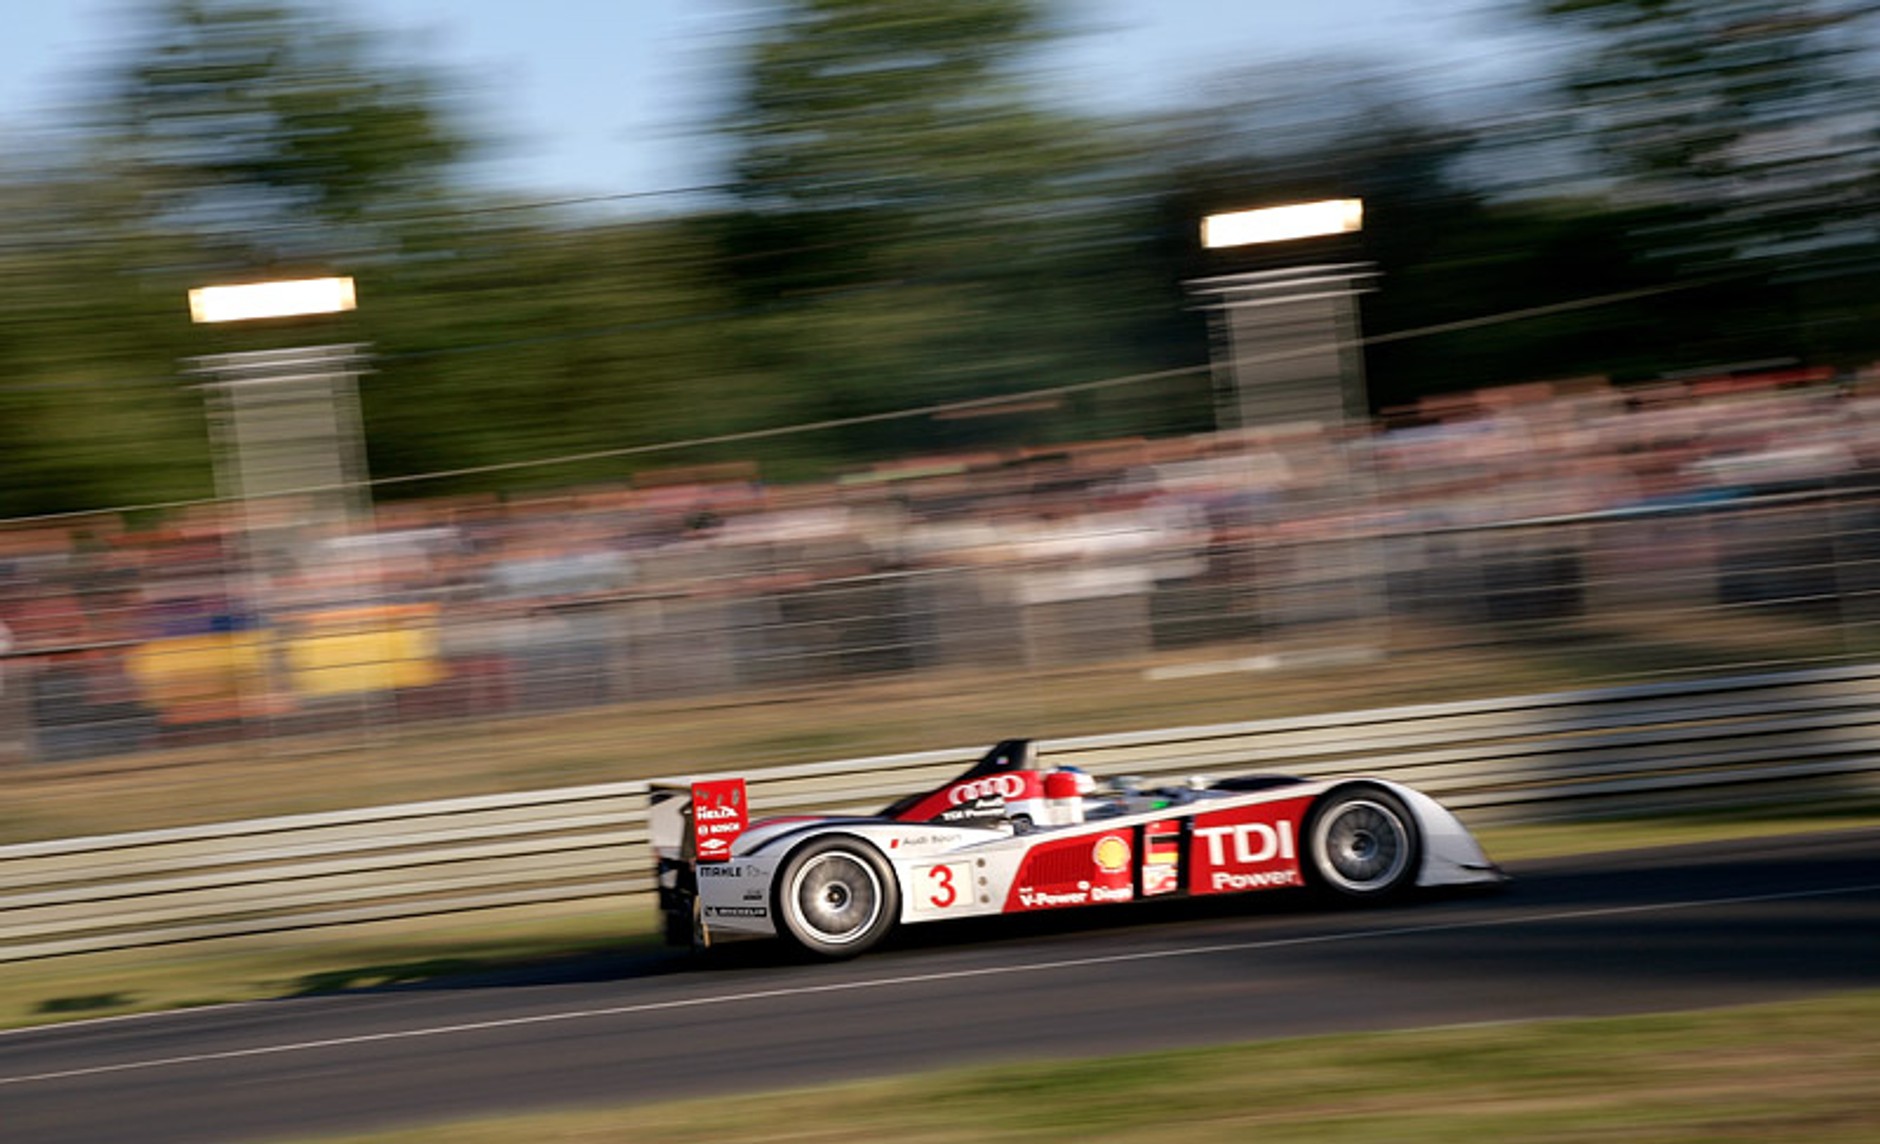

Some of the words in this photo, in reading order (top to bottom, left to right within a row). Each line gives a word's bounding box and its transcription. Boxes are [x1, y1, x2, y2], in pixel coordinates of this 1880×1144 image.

[1193, 820, 1295, 866] TDI
[928, 864, 956, 908] 3
[1211, 870, 1297, 890] Power
[1020, 893, 1088, 907] V-Power
